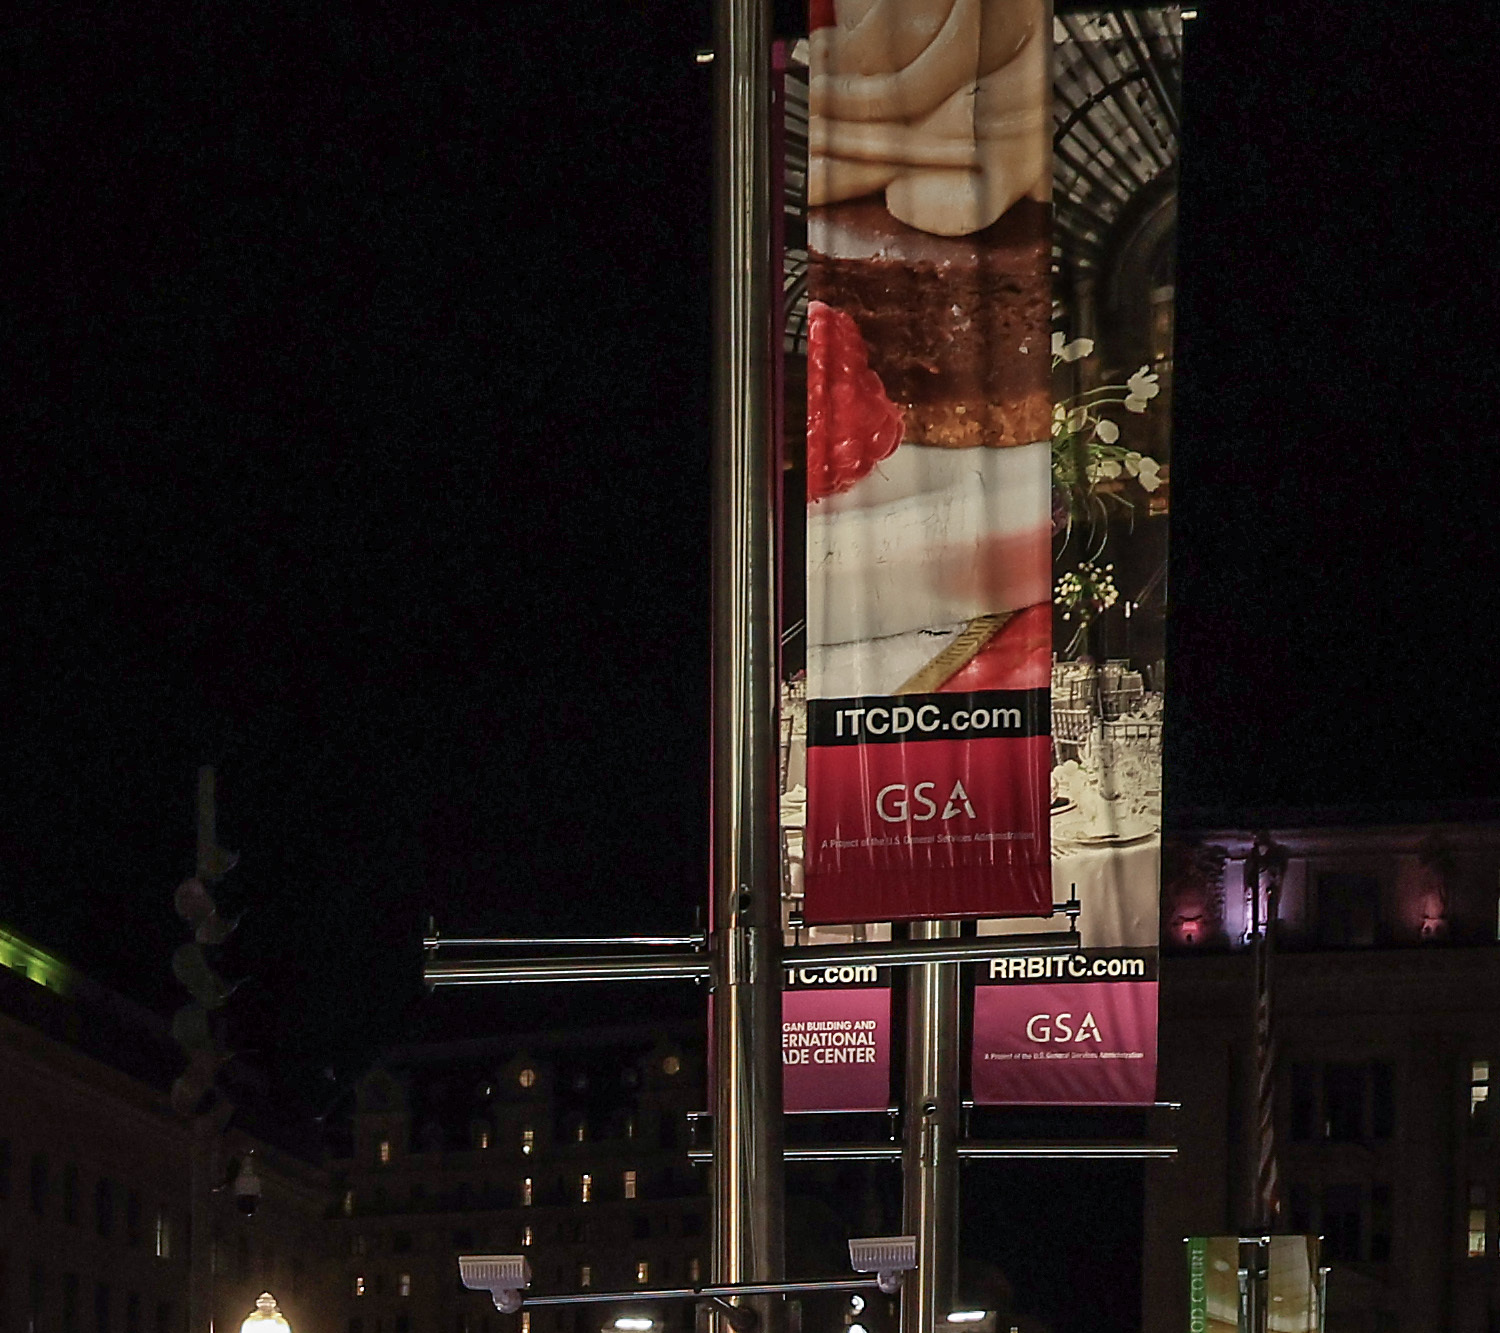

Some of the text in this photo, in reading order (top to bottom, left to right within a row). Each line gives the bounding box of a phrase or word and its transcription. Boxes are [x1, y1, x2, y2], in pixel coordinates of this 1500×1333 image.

[835, 704, 1022, 738] ITCDC.com
[876, 779, 977, 823] GSA
[787, 963, 878, 984] TC.com
[988, 955, 1146, 980] RRBITC.com
[782, 1019, 877, 1032] GAN BUILDING AND
[1026, 1011, 1103, 1044] GSA
[782, 1031, 876, 1047] ERNATIONAL
[782, 1047, 877, 1064] ADE CENTER
